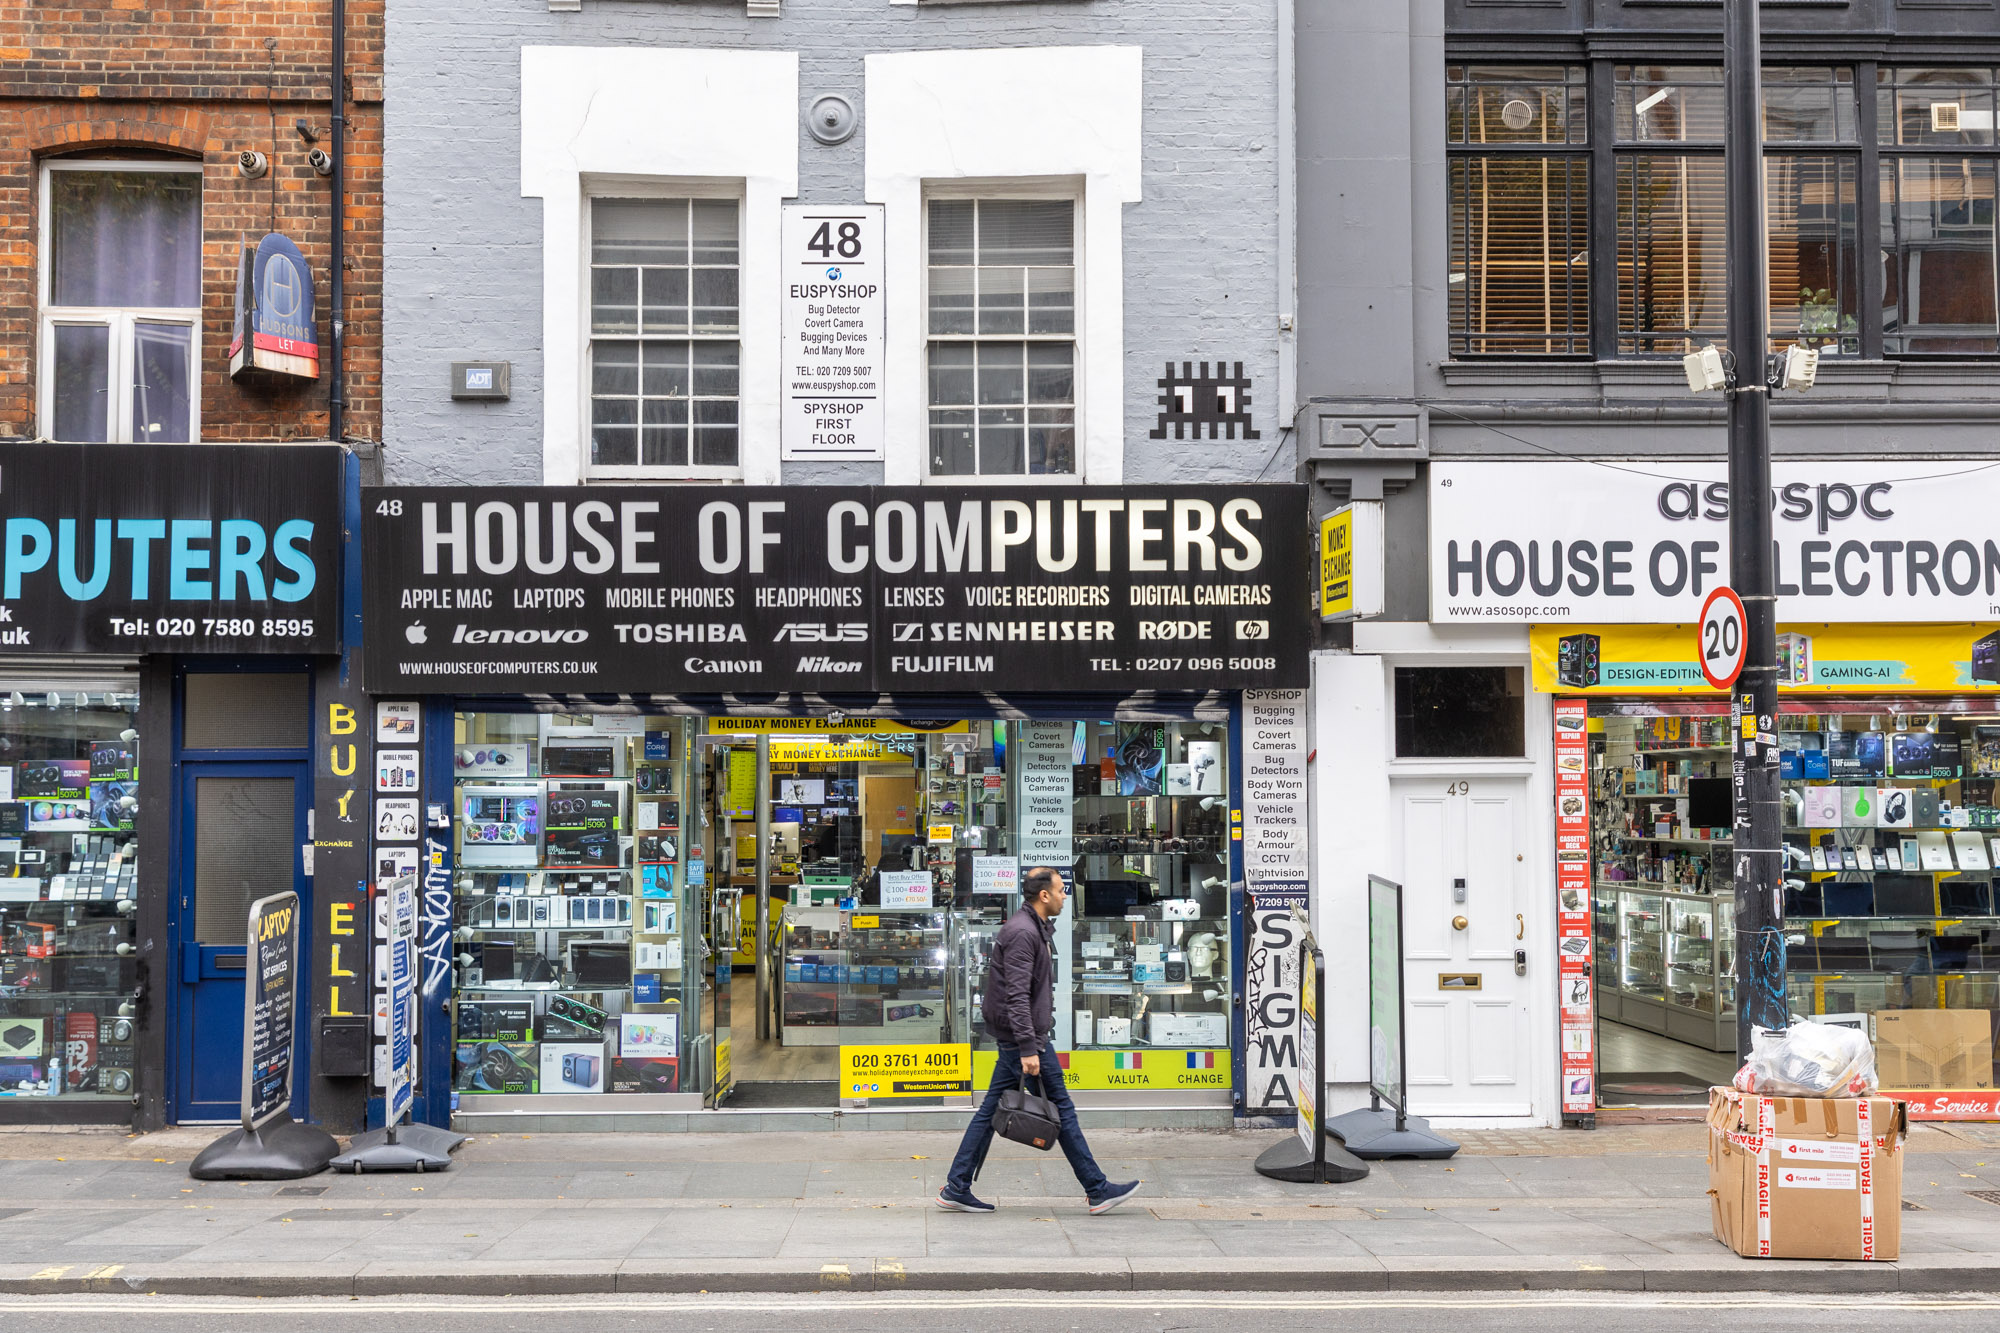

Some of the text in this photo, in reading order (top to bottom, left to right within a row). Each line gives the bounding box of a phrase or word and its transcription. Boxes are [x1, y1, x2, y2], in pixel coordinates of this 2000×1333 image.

[807, 222, 862, 259] 48
[790, 285, 877, 299] EUSPYSHOP
[808, 304, 861, 316] Bug Detector
[260, 316, 310, 339] HUDSONS
[804, 318, 864, 328] Covert Camera
[278, 338, 295, 351] LET
[801, 332, 868, 344] Bugging Devices
[803, 346, 865, 358] And Many More
[796, 366, 872, 376] TEL: 020 7209 5007
[466, 373, 492, 386] ADT
[791, 381, 877, 392] www.euspyshop.com
[803, 403, 864, 414] SPYSHOP
[815, 418, 852, 430] FIRST
[812, 433, 856, 445] FLOOR
[1440, 479, 1453, 488] 49
[376, 500, 403, 517] 48
[1658, 482, 1895, 534] asspc
[421, 498, 1263, 575] HOUSE OF COMPUTERS
[1327, 524, 1347, 553] MONEY
[4, 518, 317, 602] PUTERS
[1324, 551, 1351, 583] EXCHANGE
[1448, 540, 1635, 597] HOUSE
[1649, 540, 1720, 597] OF
[401, 588, 493, 609] APPLE MAC
[513, 588, 586, 609] LAPTOPS
[606, 587, 735, 608] MOBILE PHONES
[755, 587, 863, 608] HEADPHONES
[884, 587, 945, 608] LENSES
[965, 585, 1110, 607] VOICE RECORDERS
[1130, 584, 1272, 606] DIGITAL CAMERAS
[1448, 604, 1570, 617] www.asosopc.com
[109, 618, 314, 636] Tel: 020 7580 8595
[614, 623, 747, 643] TOSHIBA
[773, 622, 868, 642] ASUS
[930, 621, 1115, 641] SENNHEISER
[1139, 620, 1212, 640] RØDE
[452, 624, 589, 644] lenovo
[1705, 616, 1739, 660] 20
[399, 660, 598, 675] WWW.HOUSEOFCOMPUTERS.CO.UK
[684, 656, 763, 674] Canon
[796, 656, 862, 673] Nikon
[891, 655, 994, 672] FUJIFILM
[1136, 658, 1182, 671] 0207
[1188, 657, 1223, 671] 096
[1228, 657, 1276, 670] 5008
[1607, 668, 1708, 681] DESIGN-EDITIN
[1820, 667, 1891, 679] GAMING-AI
[1246, 689, 1302, 700] SPYSHOP
[1253, 706, 1295, 716] Bugging
[718, 718, 877, 729] HOLIDAY MONEY EXCHANGE
[1031, 720, 1063, 728] Devices
[1254, 717, 1294, 725] Devices
[1257, 730, 1291, 739] Covert
[1653, 717, 1681, 741] 49
[1252, 741, 1297, 750] Cameras
[329, 703, 357, 817] BUY
[783, 750, 820, 759] MONEY
[825, 749, 881, 759] EXCHANGE
[1038, 755, 1055, 763] Bug
[1027, 763, 1067, 771] Detectors
[1264, 756, 1285, 766] Bug
[1251, 766, 1299, 775] Detectors
[1933, 769, 1951, 777] 5090
[1024, 776, 1046, 785] Body
[1247, 780, 1302, 791] Body Worn
[1253, 791, 1297, 800] Cameras
[1446, 782, 1469, 796] 49
[1029, 806, 1064, 814] Trackers
[1257, 805, 1293, 813] Vehicle
[587, 821, 606, 829] 5090
[1036, 820, 1057, 828] Body
[1254, 816, 1297, 824] Trackers
[1262, 830, 1289, 840] Body
[1257, 841, 1295, 849] Armour
[1023, 854, 1070, 863] Nightvision
[1261, 855, 1290, 863] CCTV
[1260, 898, 1282, 906] 7209
[258, 908, 292, 942] LAPTOP
[1258, 914, 1298, 1107] SIGMA
[853, 1053, 958, 1067] 020 3761 4001
[852, 1068, 959, 1077] www.holidaymoneyexchange.com
[1177, 1074, 1224, 1084] CHANGE
[1107, 1075, 1150, 1084] VALUTA
[1932, 1097, 1989, 1114] Service
[1860, 1140, 1871, 1194] FRAGILE
[1759, 1165, 1769, 1219] FRAGILE
